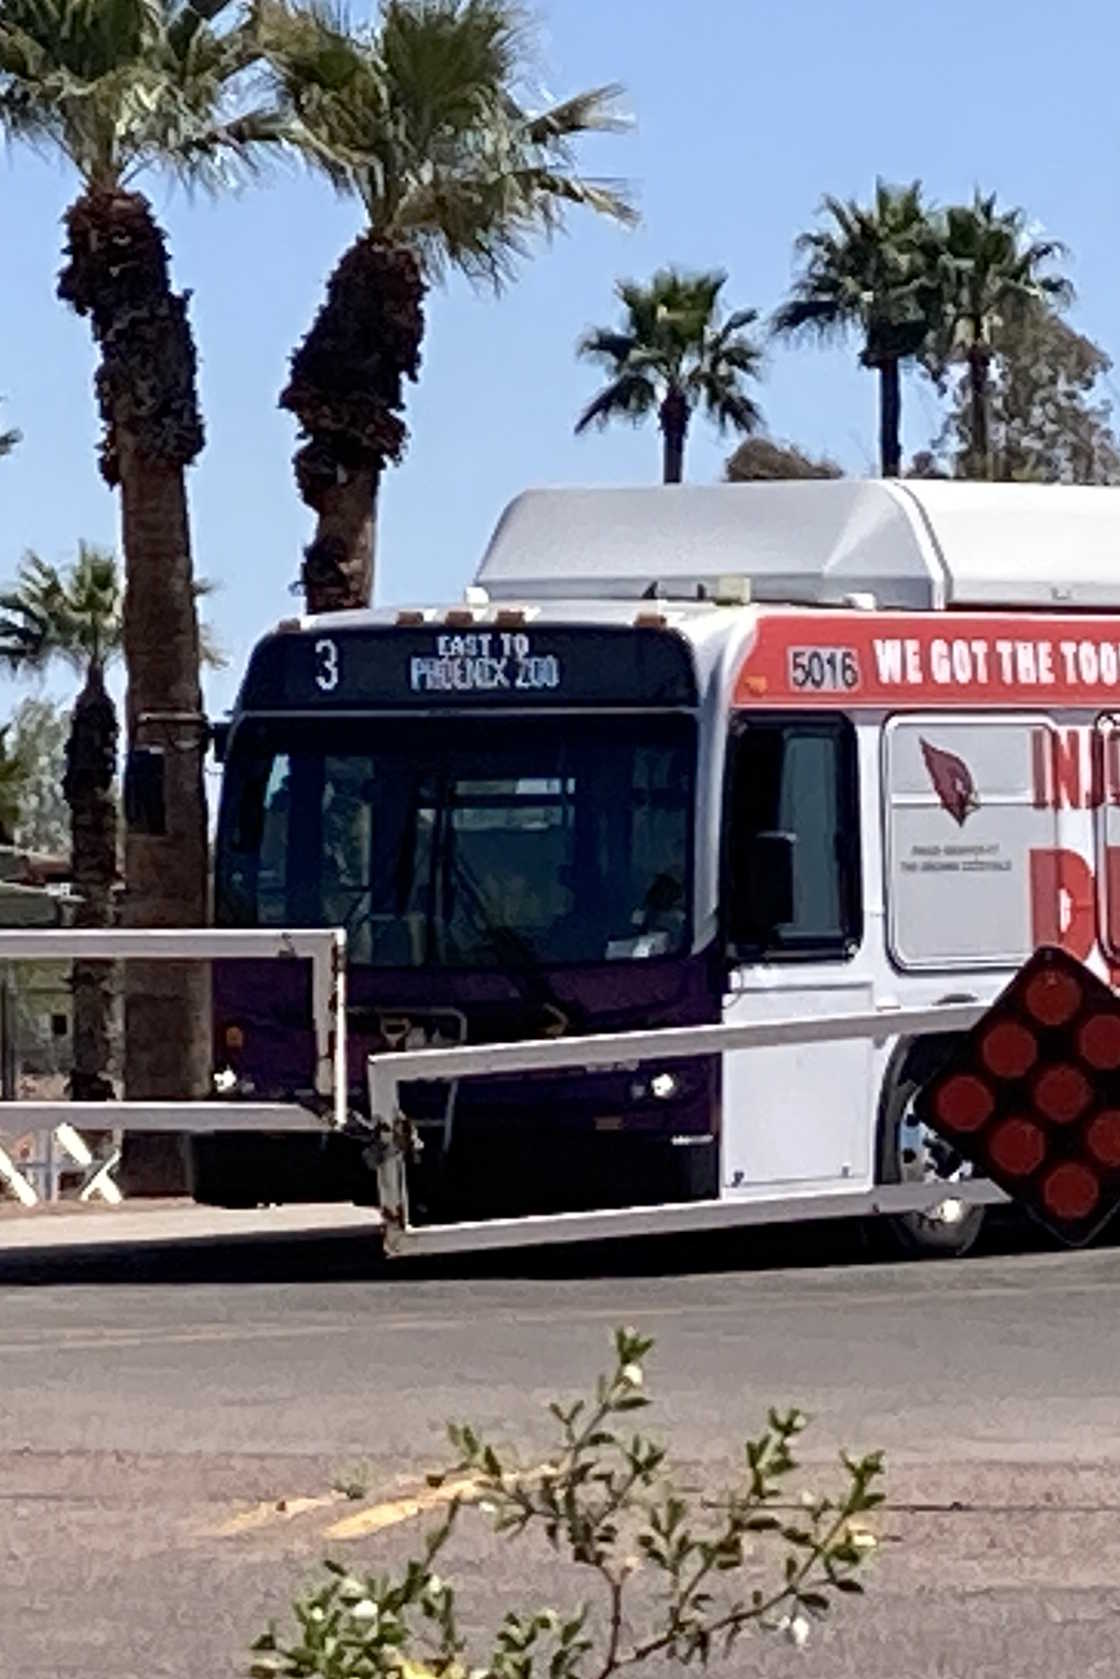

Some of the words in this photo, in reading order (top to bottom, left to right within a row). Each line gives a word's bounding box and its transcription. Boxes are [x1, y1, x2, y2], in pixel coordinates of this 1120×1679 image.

[315, 639, 339, 690] 3
[437, 633, 492, 656] EAST
[500, 633, 529, 657] TO
[873, 639, 923, 685] WE
[930, 639, 989, 685] GOT
[996, 640, 1055, 686] THE
[410, 656, 510, 690] PHOENIX
[515, 655, 560, 689] ZOO
[791, 650, 858, 689] 5016
